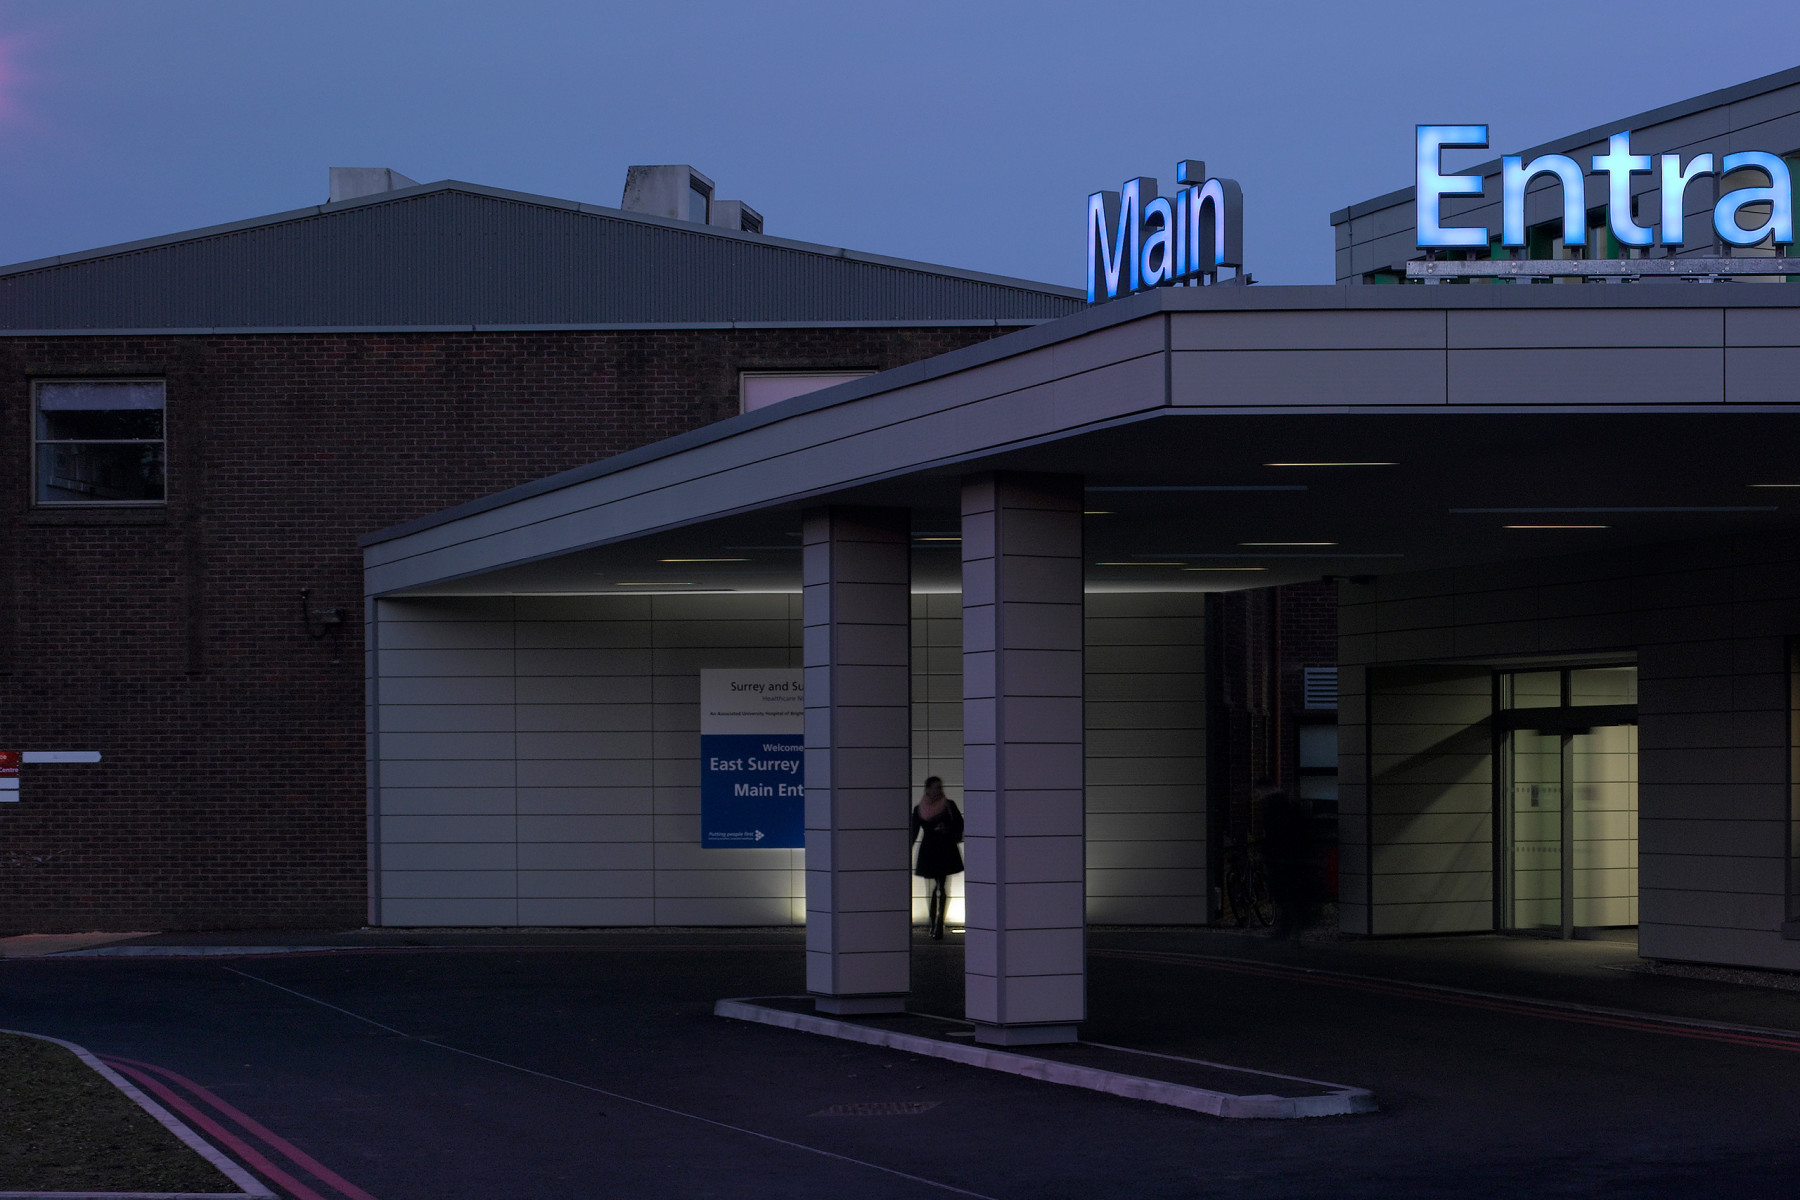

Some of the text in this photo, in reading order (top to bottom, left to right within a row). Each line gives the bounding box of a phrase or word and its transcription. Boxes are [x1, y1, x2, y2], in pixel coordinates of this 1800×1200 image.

[1087, 161, 1238, 305] Main
[730, 681, 804, 694] Surrey and Su
[762, 743, 804, 752] Welcome
[710, 757, 800, 774] East Surrey
[734, 783, 804, 797] Main Ent
